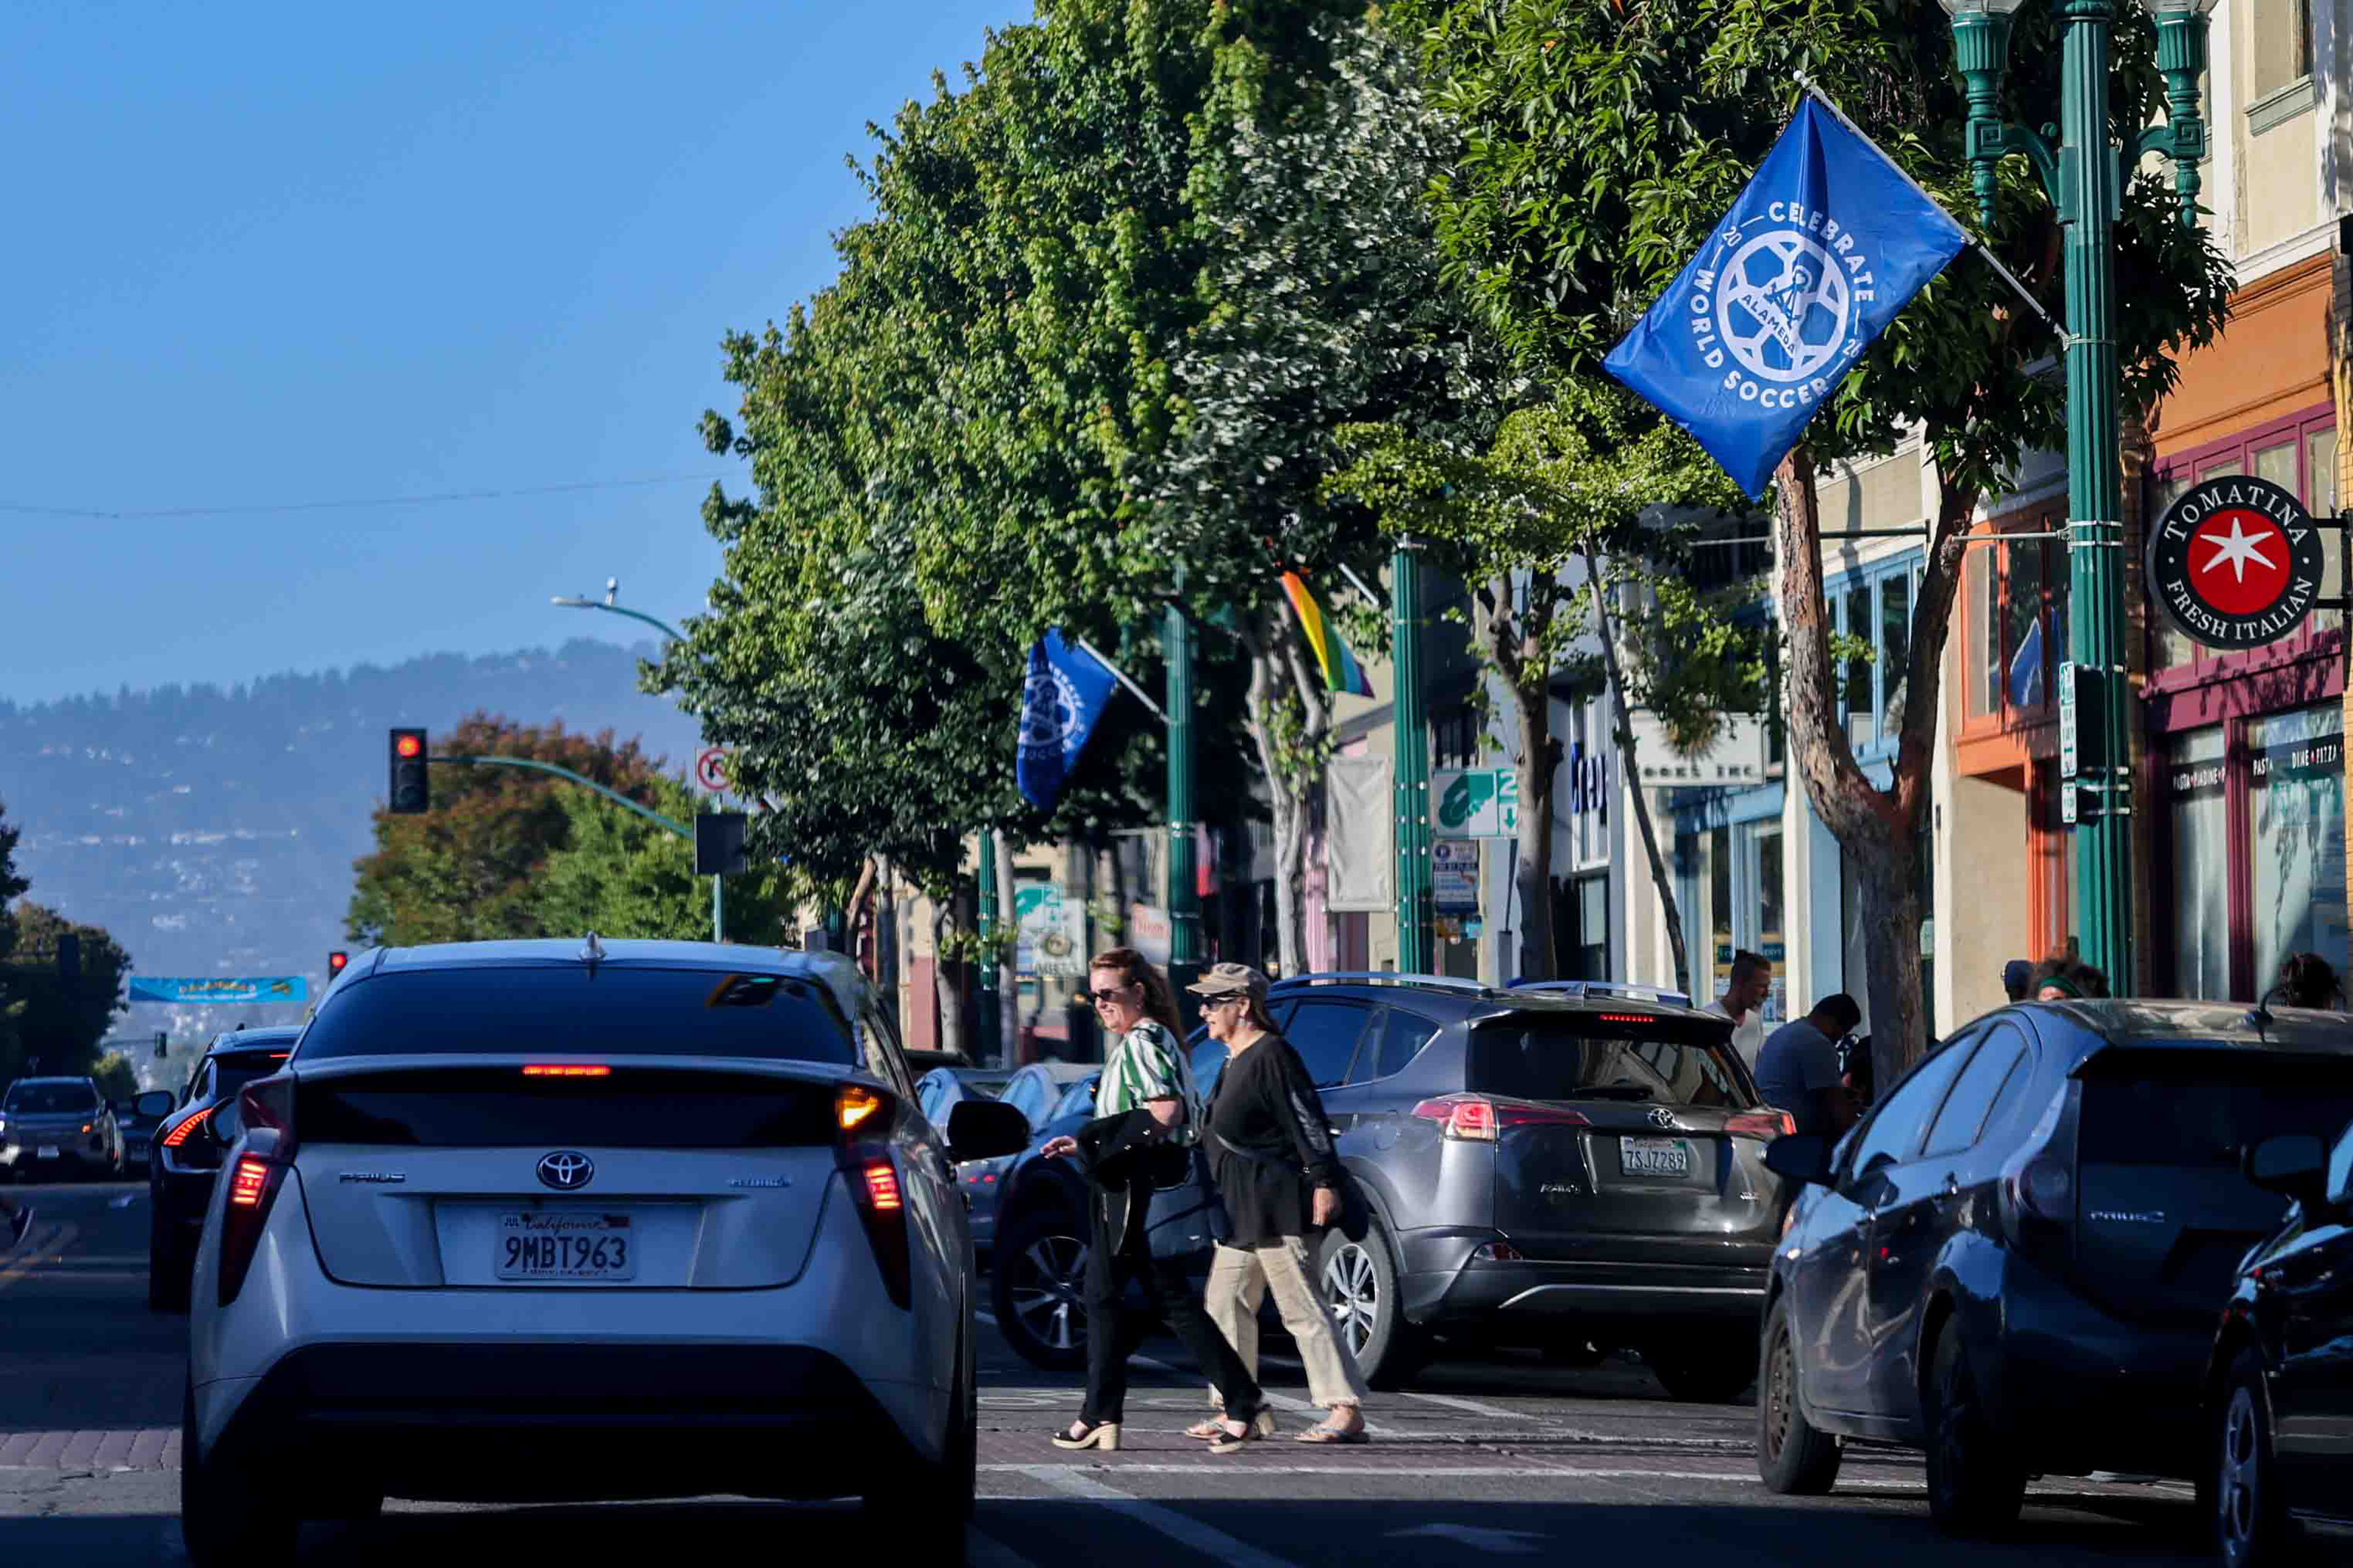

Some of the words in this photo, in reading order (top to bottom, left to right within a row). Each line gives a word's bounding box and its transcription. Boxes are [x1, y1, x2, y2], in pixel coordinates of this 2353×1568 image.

[1722, 226, 1743, 248] 20
[1768, 201, 1874, 302] CELEBRATE
[1690, 268, 1724, 368] WORLD
[1724, 370, 1829, 408] SOCCER
[1742, 294, 1796, 354] ALAMEDA
[1842, 338, 1863, 359] 26
[2164, 484, 2308, 546] TOMATINA
[2166, 578, 2228, 639] FRESH
[2235, 576, 2313, 640] ITALIAN
[1644, 766, 1701, 777] OOKS
[2253, 758, 2274, 776] PASTA
[2292, 750, 2310, 769] DINE
[2316, 744, 2337, 764] PIZZA
[504, 1216, 519, 1227] JUL
[504, 1236, 626, 1268] 9MBT963
